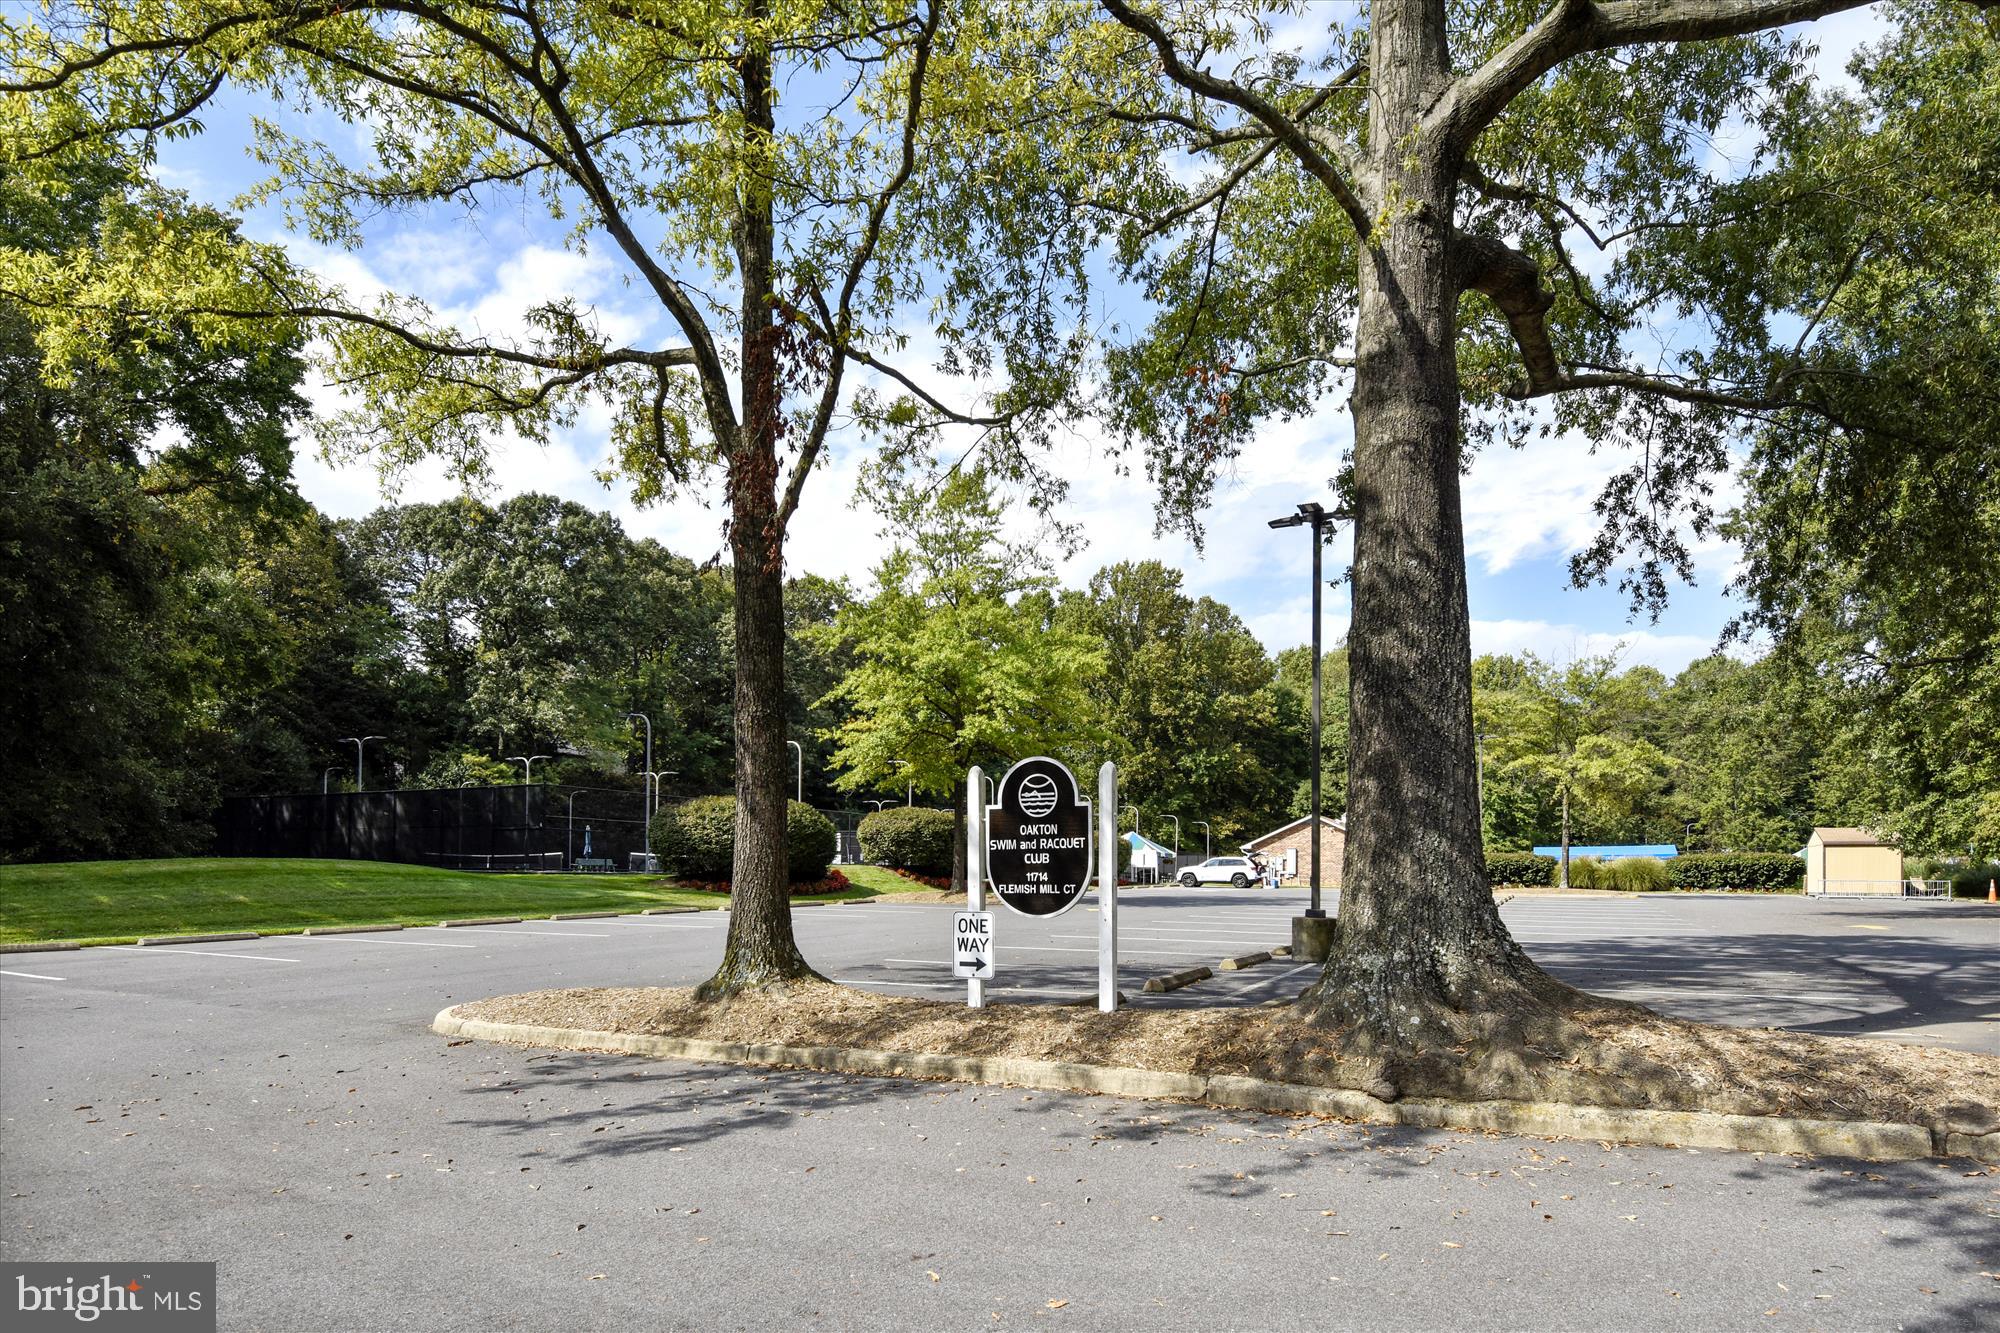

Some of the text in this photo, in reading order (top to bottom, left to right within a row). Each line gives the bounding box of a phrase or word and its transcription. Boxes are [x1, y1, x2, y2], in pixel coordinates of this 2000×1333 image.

[1019, 824, 1058, 835] OAKTON
[990, 837, 1086, 850] SWIM and RACQUET
[1024, 853, 1050, 864] CLUB
[1026, 872, 1048, 882] 11714
[999, 883, 1076, 894] FLEMISH MILL CT
[958, 918, 989, 934] ONE
[957, 937, 989, 953] WAY
